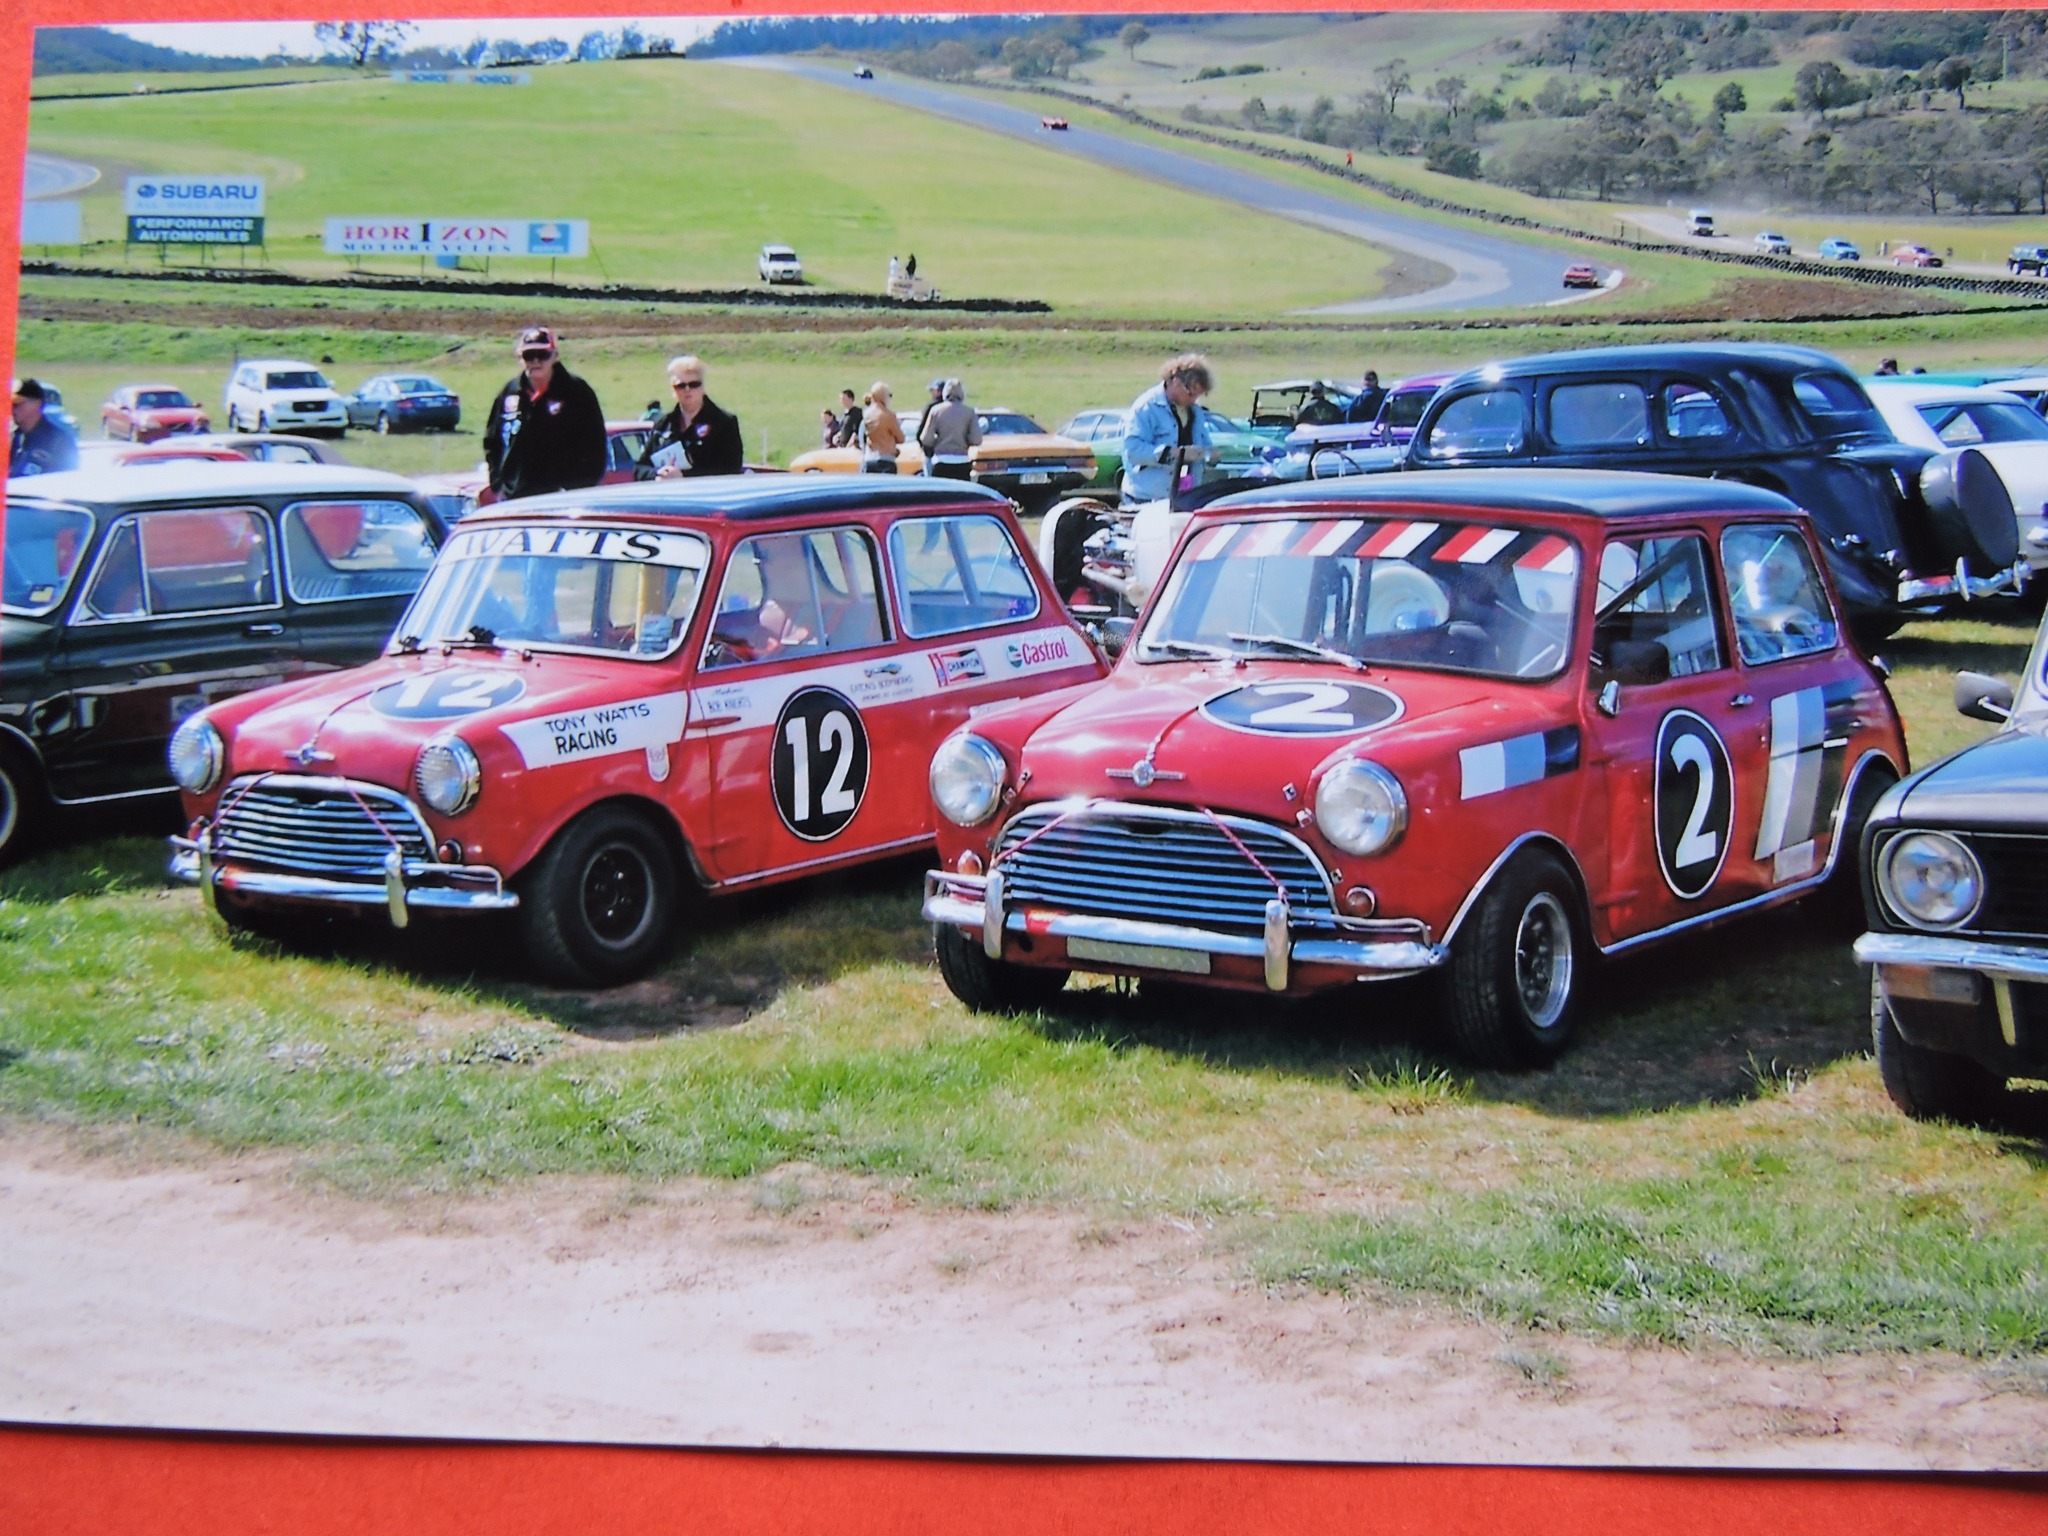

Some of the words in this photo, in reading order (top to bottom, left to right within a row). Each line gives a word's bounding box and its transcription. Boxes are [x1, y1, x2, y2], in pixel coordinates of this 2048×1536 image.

[161, 184, 258, 200] SUBARU
[135, 217, 254, 231] PERFORMANCE
[138, 229, 250, 243] AUTOMOBILES
[343, 243, 511, 252] MOTORCYCLES
[466, 527, 662, 559] WATTS
[946, 656, 981, 673] CHAMPION
[1022, 636, 1069, 665] Castrol
[396, 672, 511, 709] 12
[1250, 683, 1354, 726] 2
[545, 714, 587, 734] TONY
[594, 702, 651, 725] WATTS
[554, 727, 618, 756] RACING
[785, 709, 856, 822] 12
[1670, 733, 1717, 869] 2
